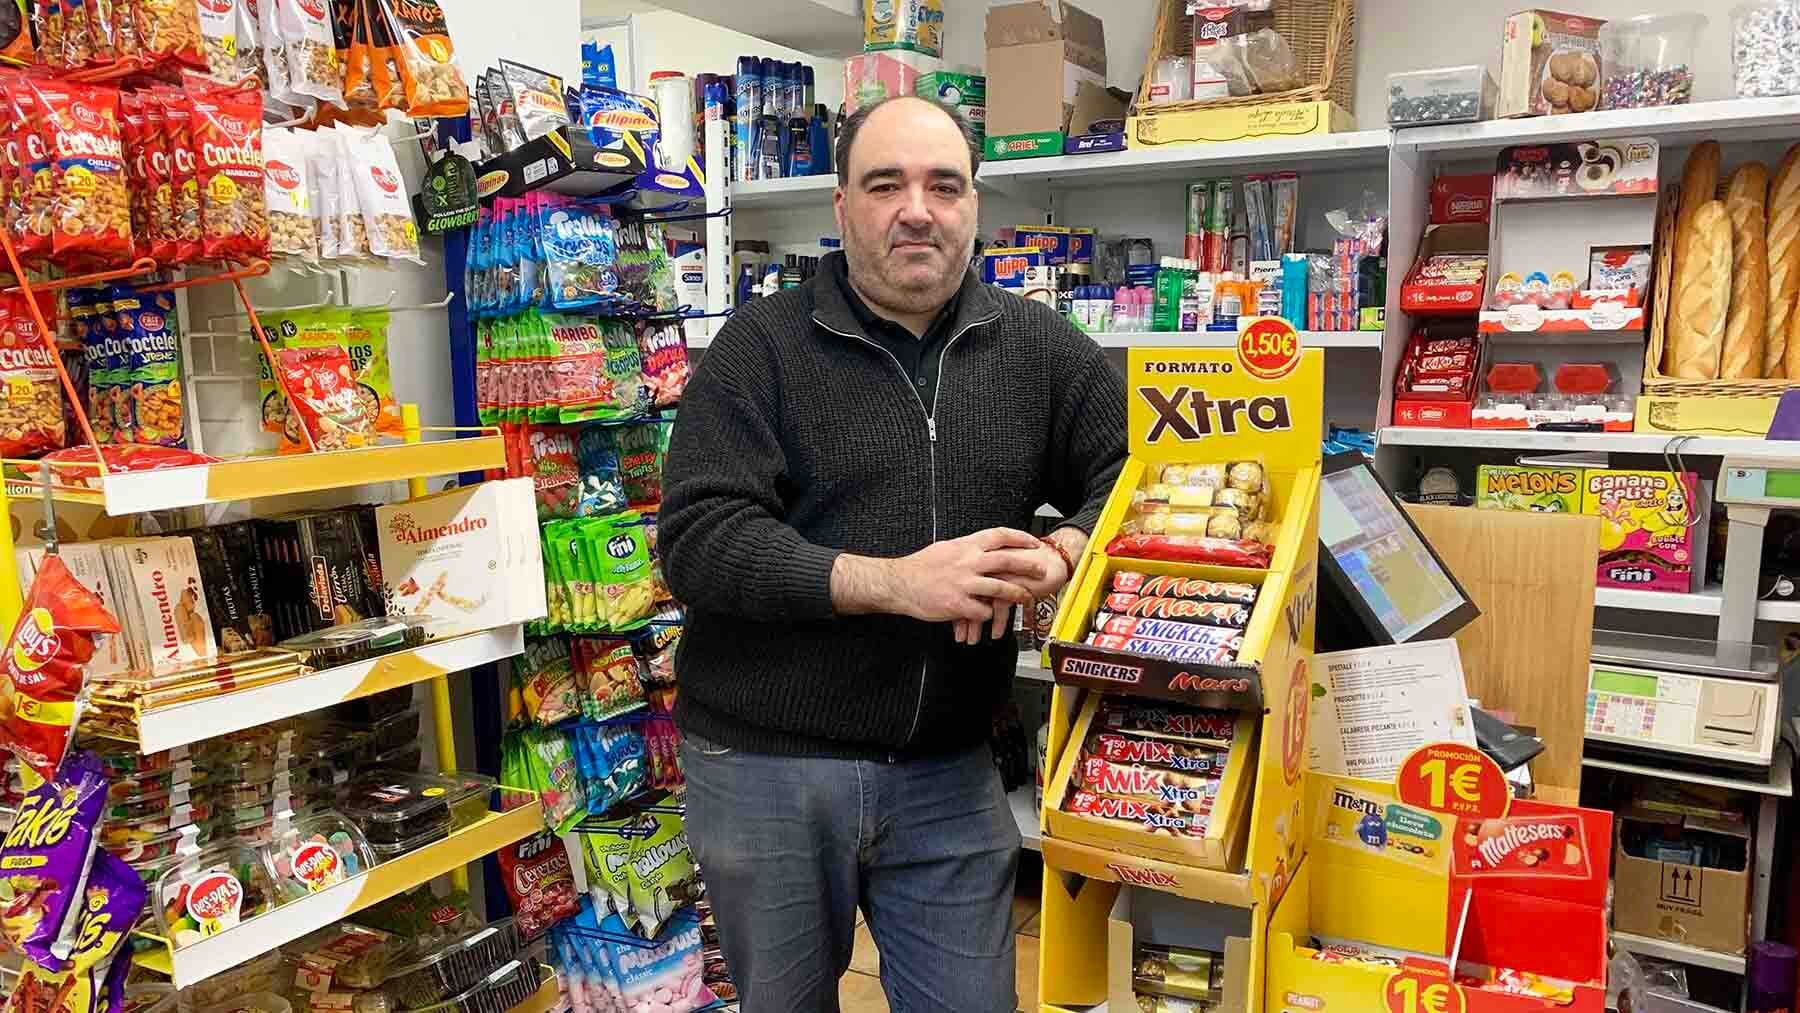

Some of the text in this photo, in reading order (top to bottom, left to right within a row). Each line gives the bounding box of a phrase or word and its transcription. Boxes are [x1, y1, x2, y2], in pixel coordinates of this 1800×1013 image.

[1007, 139, 1038, 151] ARIEL
[551, 325, 599, 343] HARIBO
[1244, 332, 1297, 358] 1,50€
[1144, 362, 1233, 374] FORMATO
[1138, 386, 1292, 443] Xtra
[623, 452, 656, 469] Cherry
[1589, 475, 1667, 493] Banana
[407, 517, 488, 545] Almendro
[608, 536, 635, 556] Fini
[1609, 566, 1652, 583] Fini
[223, 585, 239, 621] FRUTAS
[1126, 596, 1235, 620] Mars
[150, 569, 179, 664] Almendro
[1064, 659, 1139, 682] SNICKERS
[1168, 671, 1250, 692] Mars
[1170, 756, 1209, 769] Xtra
[1427, 749, 1482, 763] PROMOCIÓN
[1099, 762, 1162, 794] TWIX
[1419, 760, 1483, 809] 1€
[1160, 785, 1198, 802] Xtra
[3, 794, 78, 849] Takis
[1145, 813, 1186, 828] Xtra
[1478, 823, 1563, 867] Maltesers
[513, 853, 570, 897] Cerezas
[1656, 903, 1674, 912] MUY
[1394, 976, 1450, 1010] 1€
